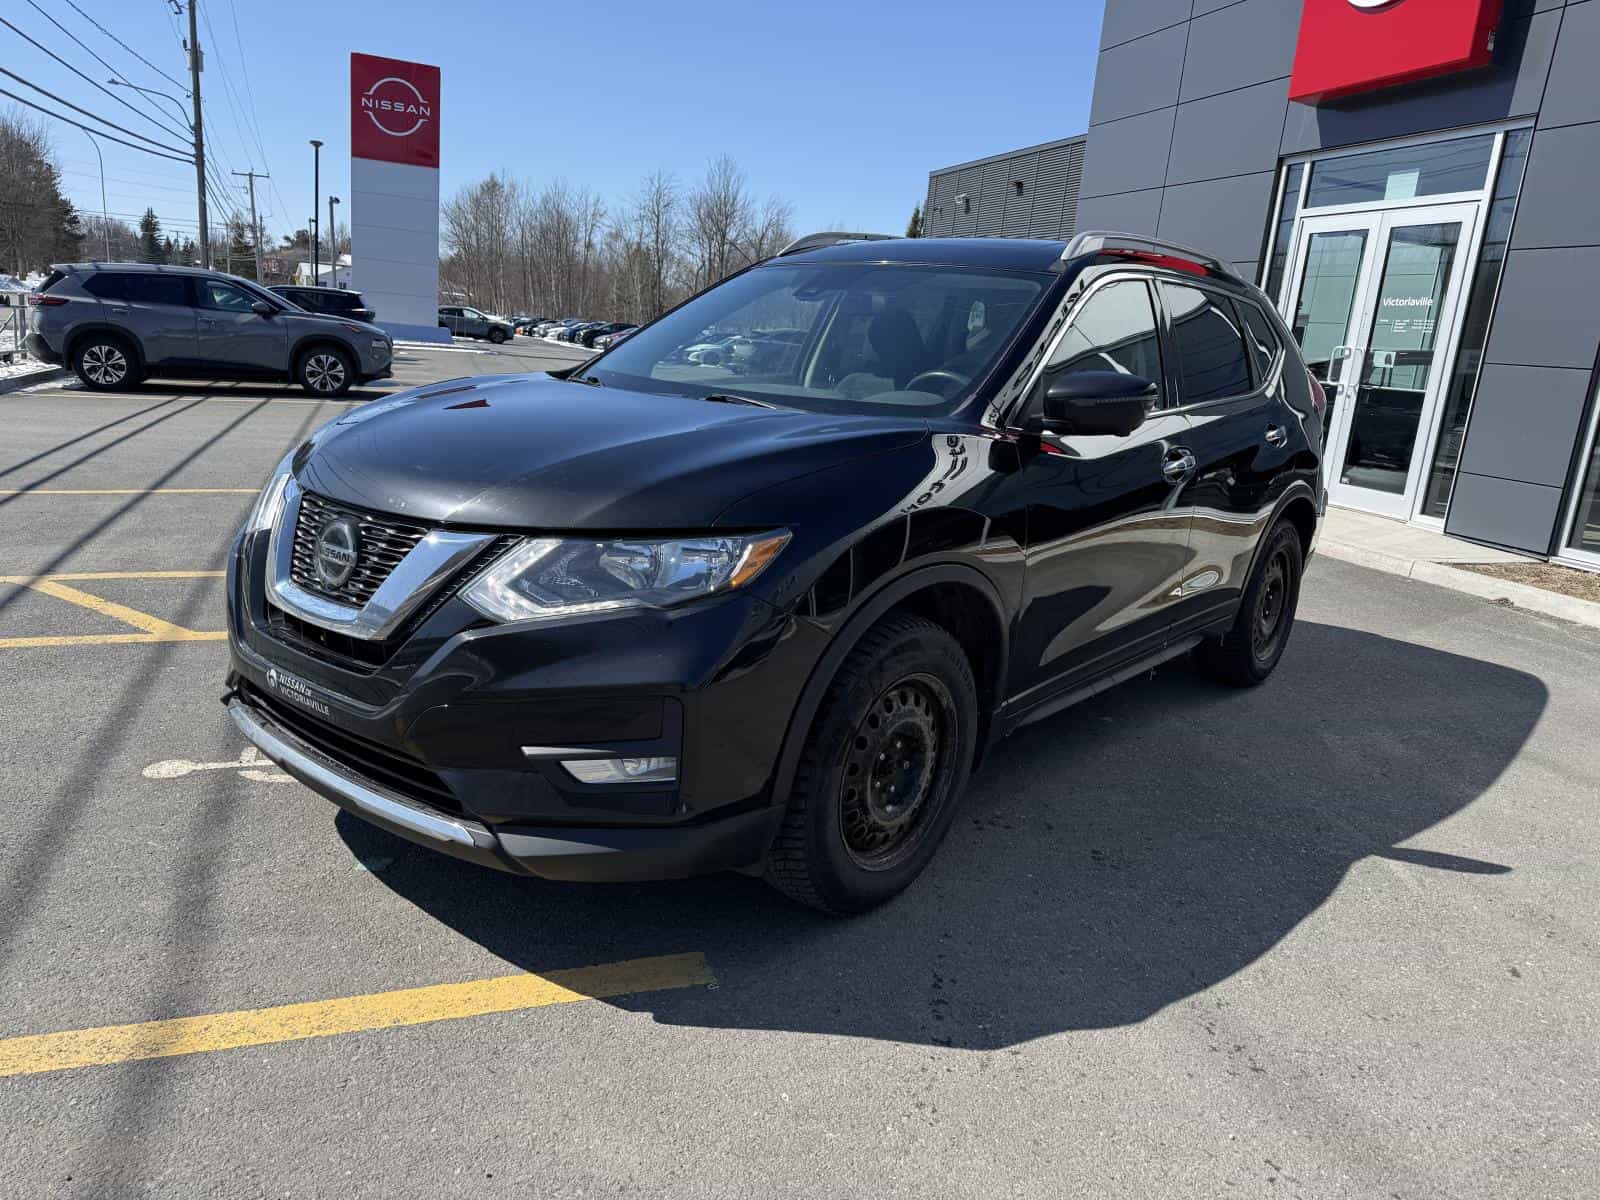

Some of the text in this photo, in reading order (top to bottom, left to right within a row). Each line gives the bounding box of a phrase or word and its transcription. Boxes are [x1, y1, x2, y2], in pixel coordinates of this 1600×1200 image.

[361, 97, 431, 116] NISSAN
[1383, 296, 1433, 306] Victoriaville
[280, 673, 306, 694] NISSAN
[280, 686, 330, 716] VICTORIAVILLE
